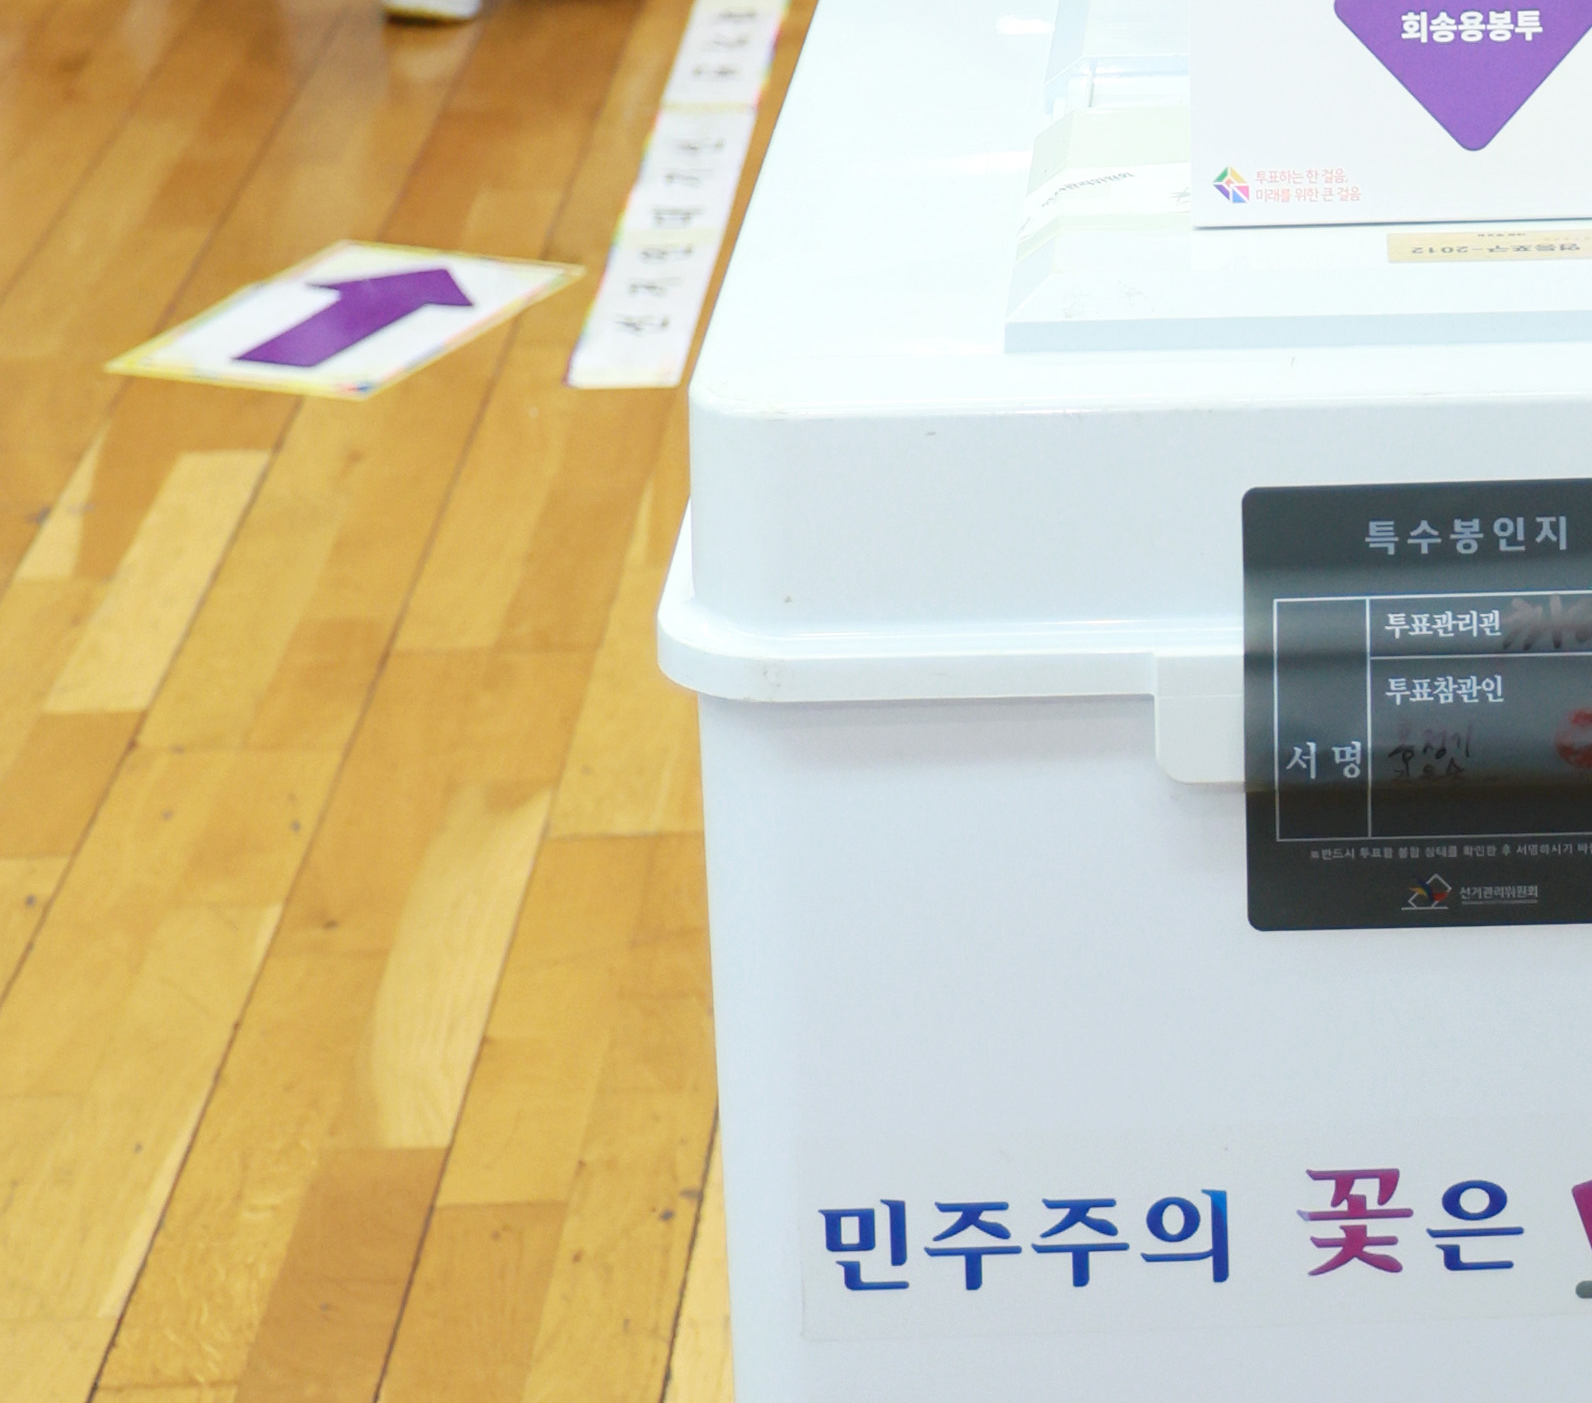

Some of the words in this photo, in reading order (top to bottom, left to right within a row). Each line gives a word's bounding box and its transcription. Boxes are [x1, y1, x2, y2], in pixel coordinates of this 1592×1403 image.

[1400, 10, 1543, 43] 회송용봉투
[1255, 169, 1304, 185] 투표하는
[1306, 169, 1319, 184] 한
[1255, 188, 1291, 203] 미래를
[1294, 188, 1319, 202] 위한
[1322, 187, 1334, 202] 큰
[1337, 186, 1361, 202] 걸음
[1364, 516, 1568, 555] 특수봉인지
[1385, 675, 1504, 705] 투표참관인
[1459, 885, 1539, 900] 선거관리위원회
[819, 1189, 1231, 1293] 민주주의
[1297, 1167, 1526, 1278] 꽃은
